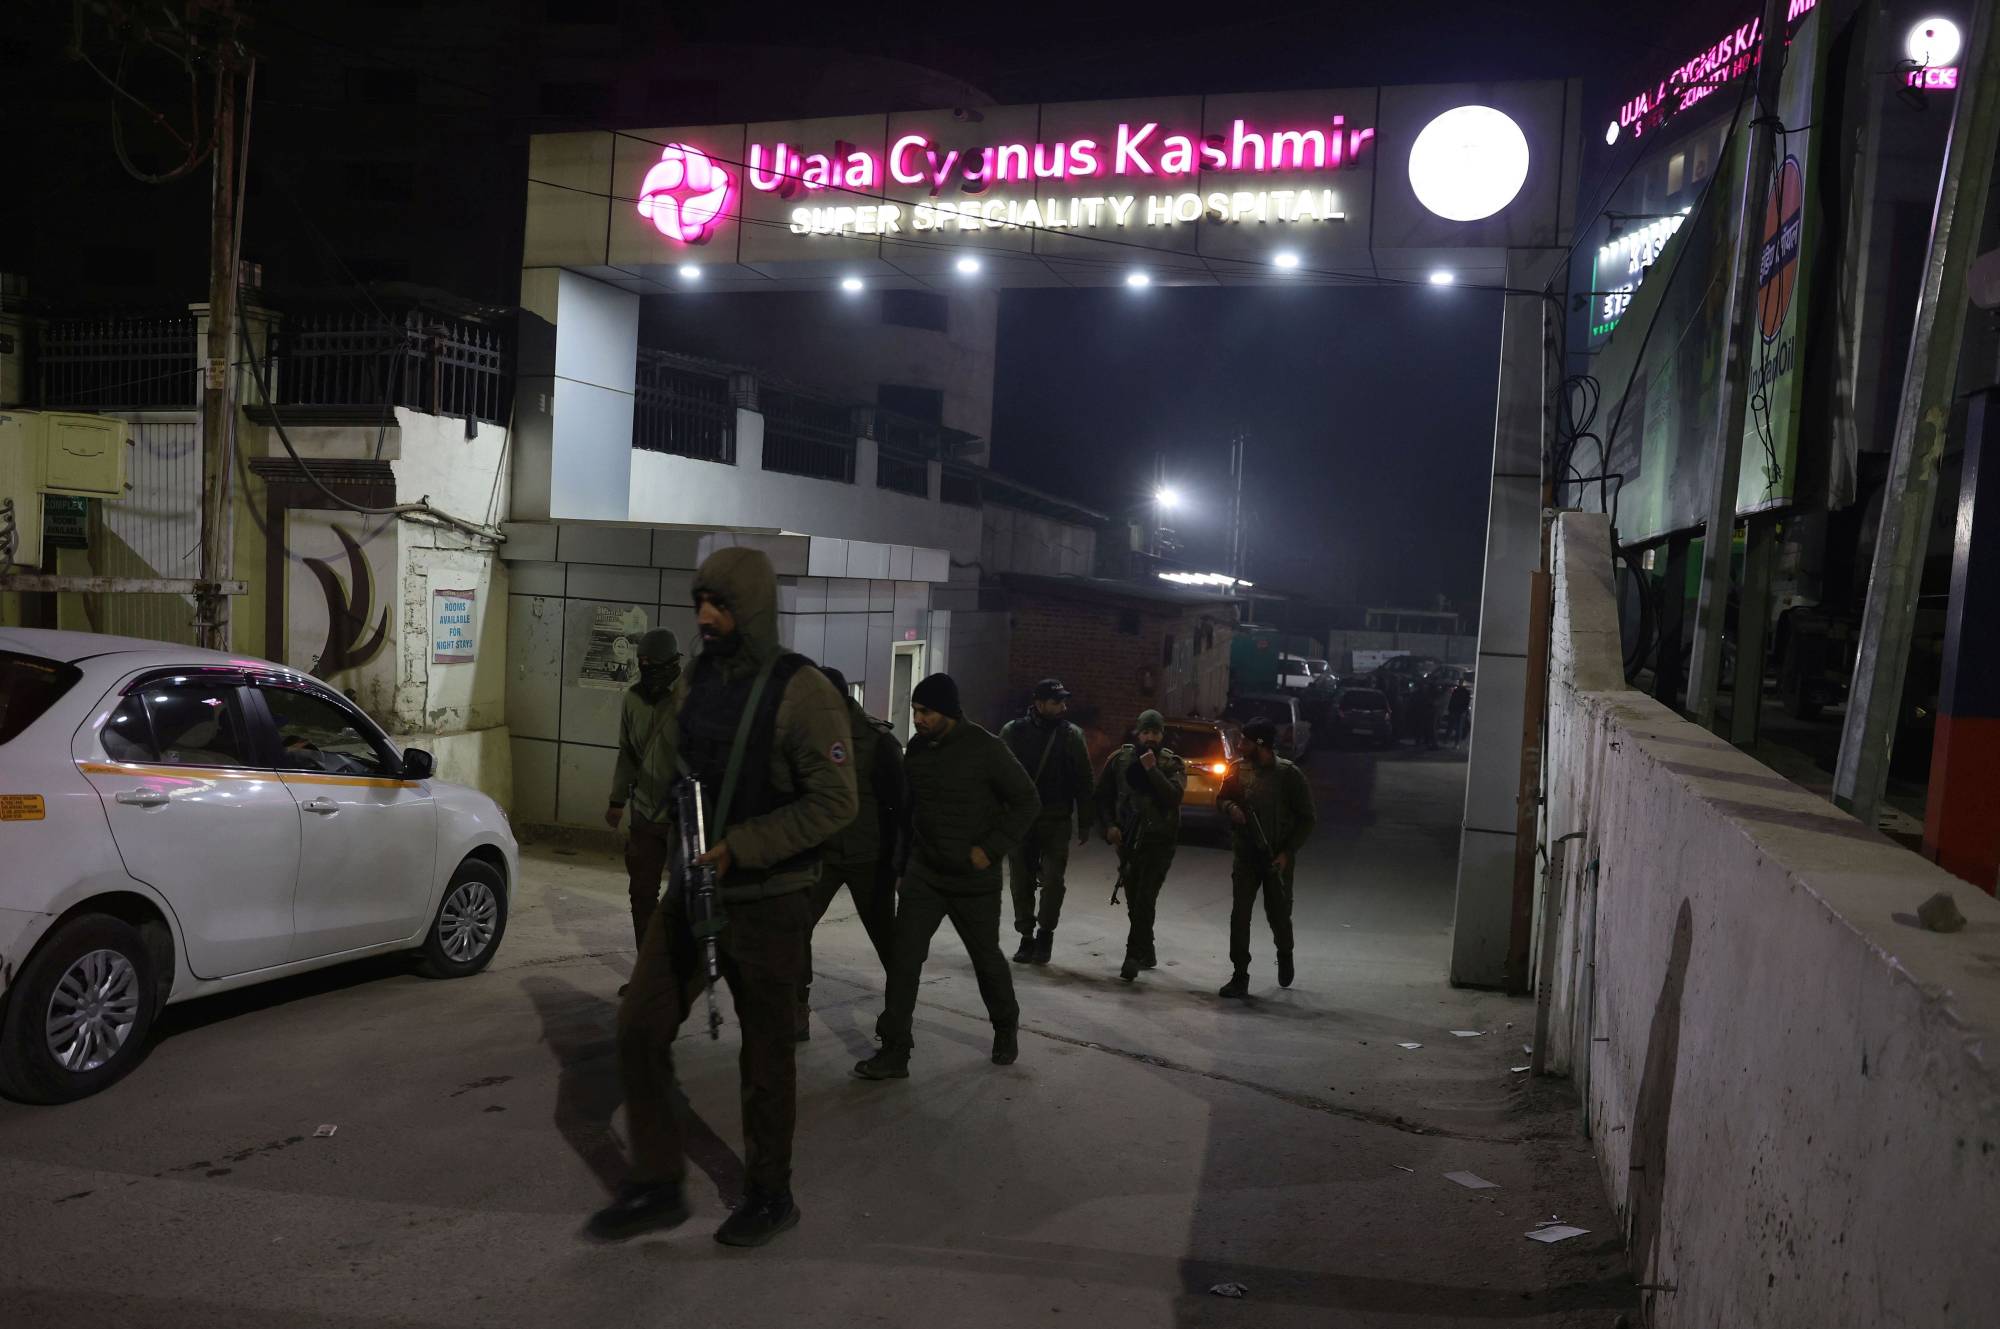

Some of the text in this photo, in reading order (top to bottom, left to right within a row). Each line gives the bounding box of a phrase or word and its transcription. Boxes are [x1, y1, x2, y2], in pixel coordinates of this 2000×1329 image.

[748, 115, 1375, 198] Ujala Cygnus Kashmir
[790, 188, 1346, 236] SUPER SPECIALITY HOSPITAL
[444, 602, 466, 612] ROOMS
[439, 614, 471, 625] AVAILABLE
[449, 627, 461, 637] FOR
[436, 639, 473, 651] NIGHT STAYS
